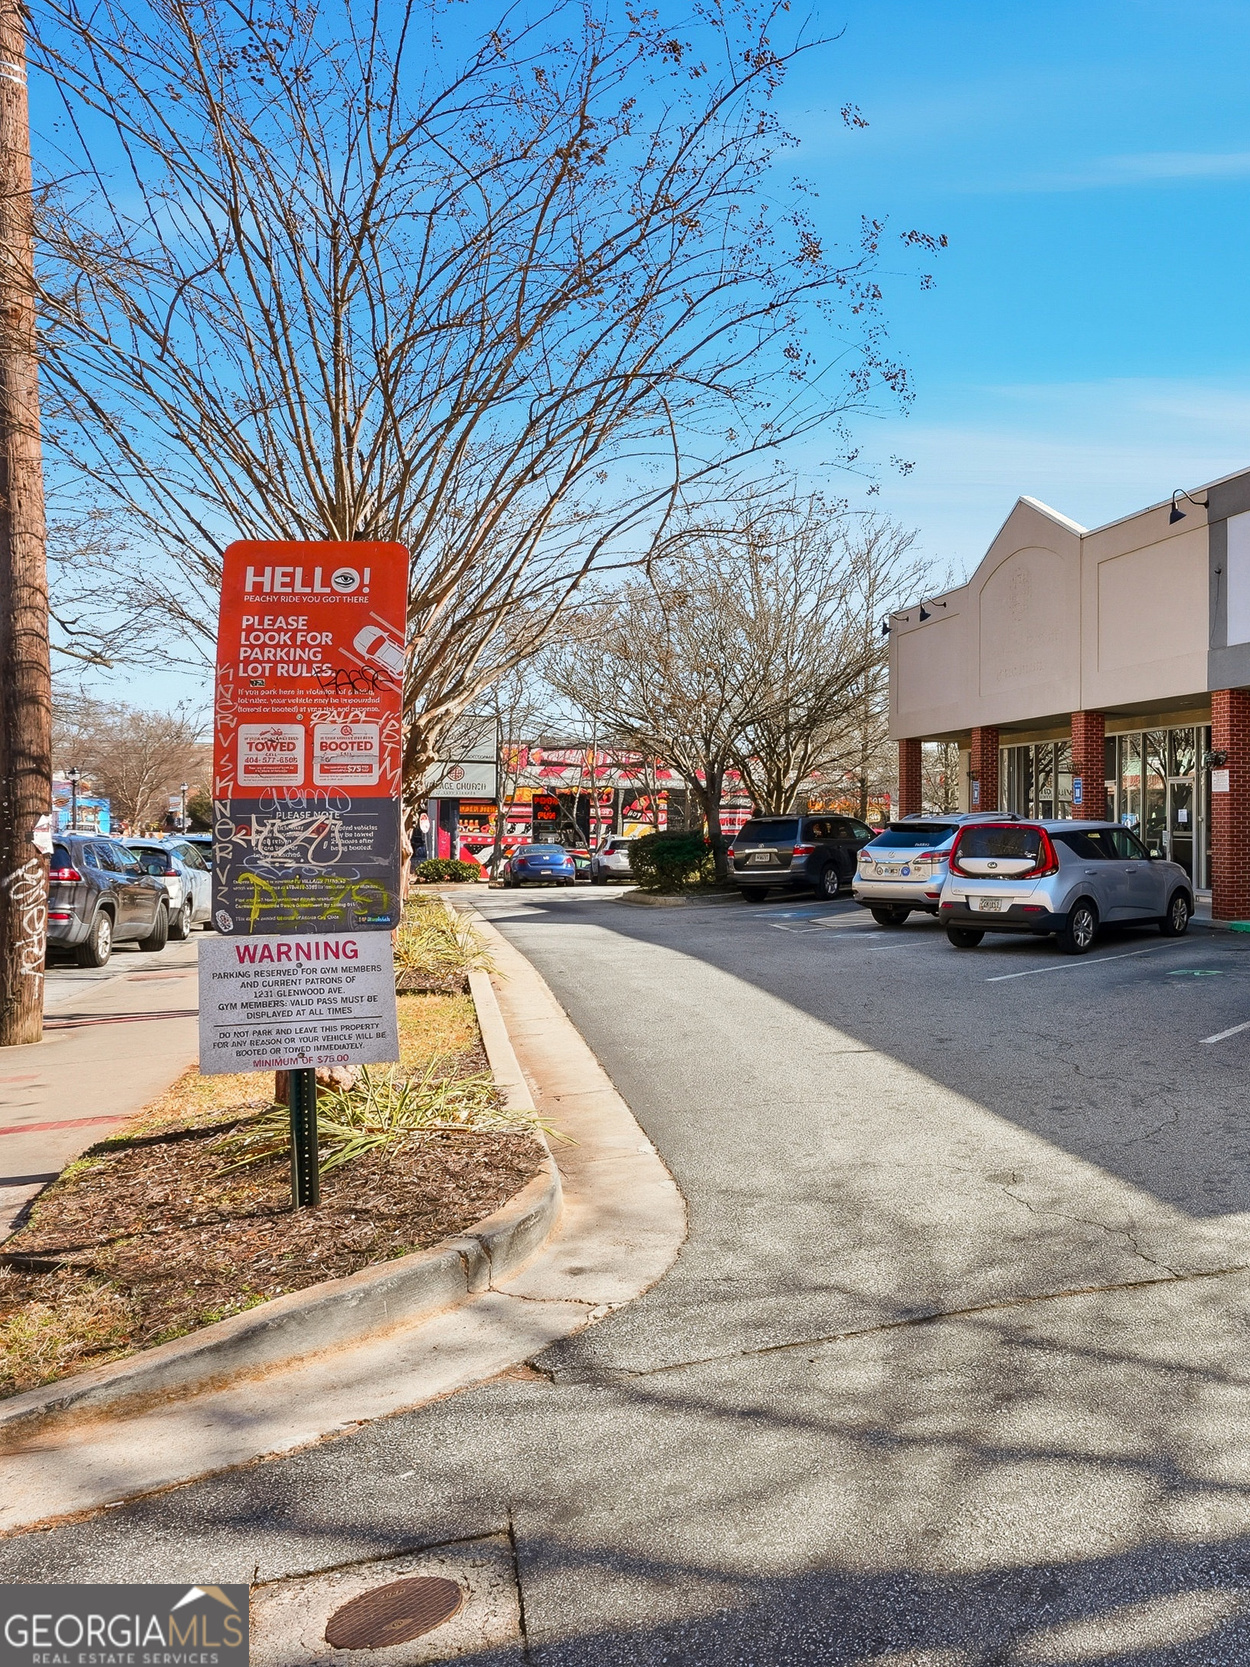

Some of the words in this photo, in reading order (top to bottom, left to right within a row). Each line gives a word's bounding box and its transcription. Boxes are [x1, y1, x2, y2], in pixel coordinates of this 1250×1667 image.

[244, 566, 371, 594] HELLO!
[244, 595, 280, 603] PEACHY
[280, 595, 301, 603] RIDE
[302, 595, 321, 603] YOU
[342, 596, 369, 604] THERE
[241, 615, 308, 629] PLEASE
[240, 632, 292, 645] LOOK
[296, 632, 333, 646] FOR
[239, 648, 322, 661] PARKING
[238, 664, 274, 677] LOT
[277, 664, 337, 678] RULES.
[246, 741, 297, 752] TOWED
[320, 741, 373, 752] BOOTED
[456, 782, 487, 791] CHURCH
[276, 811, 311, 820] PLEASE
[235, 940, 358, 964] WARNING
[212, 970, 251, 980] PARKING
[253, 968, 298, 978] RESERVED
[301, 967, 317, 975] FOR
[320, 966, 338, 974] GYM
[341, 965, 382, 973] MEMBERS
[240, 980, 259, 989] AND
[262, 979, 302, 988] CURRENT
[305, 977, 343, 985] PATRONS
[253, 991, 274, 999] 1231
[276, 988, 325, 998] GLENWOOD
[327, 987, 346, 995] AVE.
[218, 1003, 238, 1012] GYM
[240, 1000, 288, 1010] MEMBERS:
[290, 998, 314, 1007] VALID
[316, 997, 338, 1005] PASS
[340, 996, 364, 1004] MUST
[367, 995, 378, 1003] BE
[246, 1009, 294, 1020] DISPLAYED
[295, 1009, 306, 1017] AT
[308, 1007, 324, 1016] ALL
[327, 1006, 353, 1015] TIMES
[219, 1031, 231, 1039] DO
[233, 1030, 250, 1038] NOT
[252, 1029, 273, 1037] PARK
[275, 1028, 292, 1036] AND
[294, 1026, 318, 1035] LEAVE
[320, 1025, 338, 1033] THIS
[340, 1023, 380, 1032] PROPERTY
[212, 1041, 229, 1049] FOR
[231, 1040, 247, 1048] ANY
[249, 1038, 282, 1047] REASON
[284, 1037, 296, 1045] OR
[298, 1036, 319, 1044] YOUR
[321, 1034, 353, 1042] VEHICLE
[355, 1032, 373, 1041] WILL
[375, 1031, 386, 1039] BE
[235, 1048, 267, 1057] BOOTED
[269, 1047, 281, 1056] OR
[284, 1046, 312, 1054] TOWED
[313, 1042, 365, 1053] IMMEDIATELY.
[252, 1057, 299, 1068] MINIMUM
[301, 1056, 314, 1065] OF
